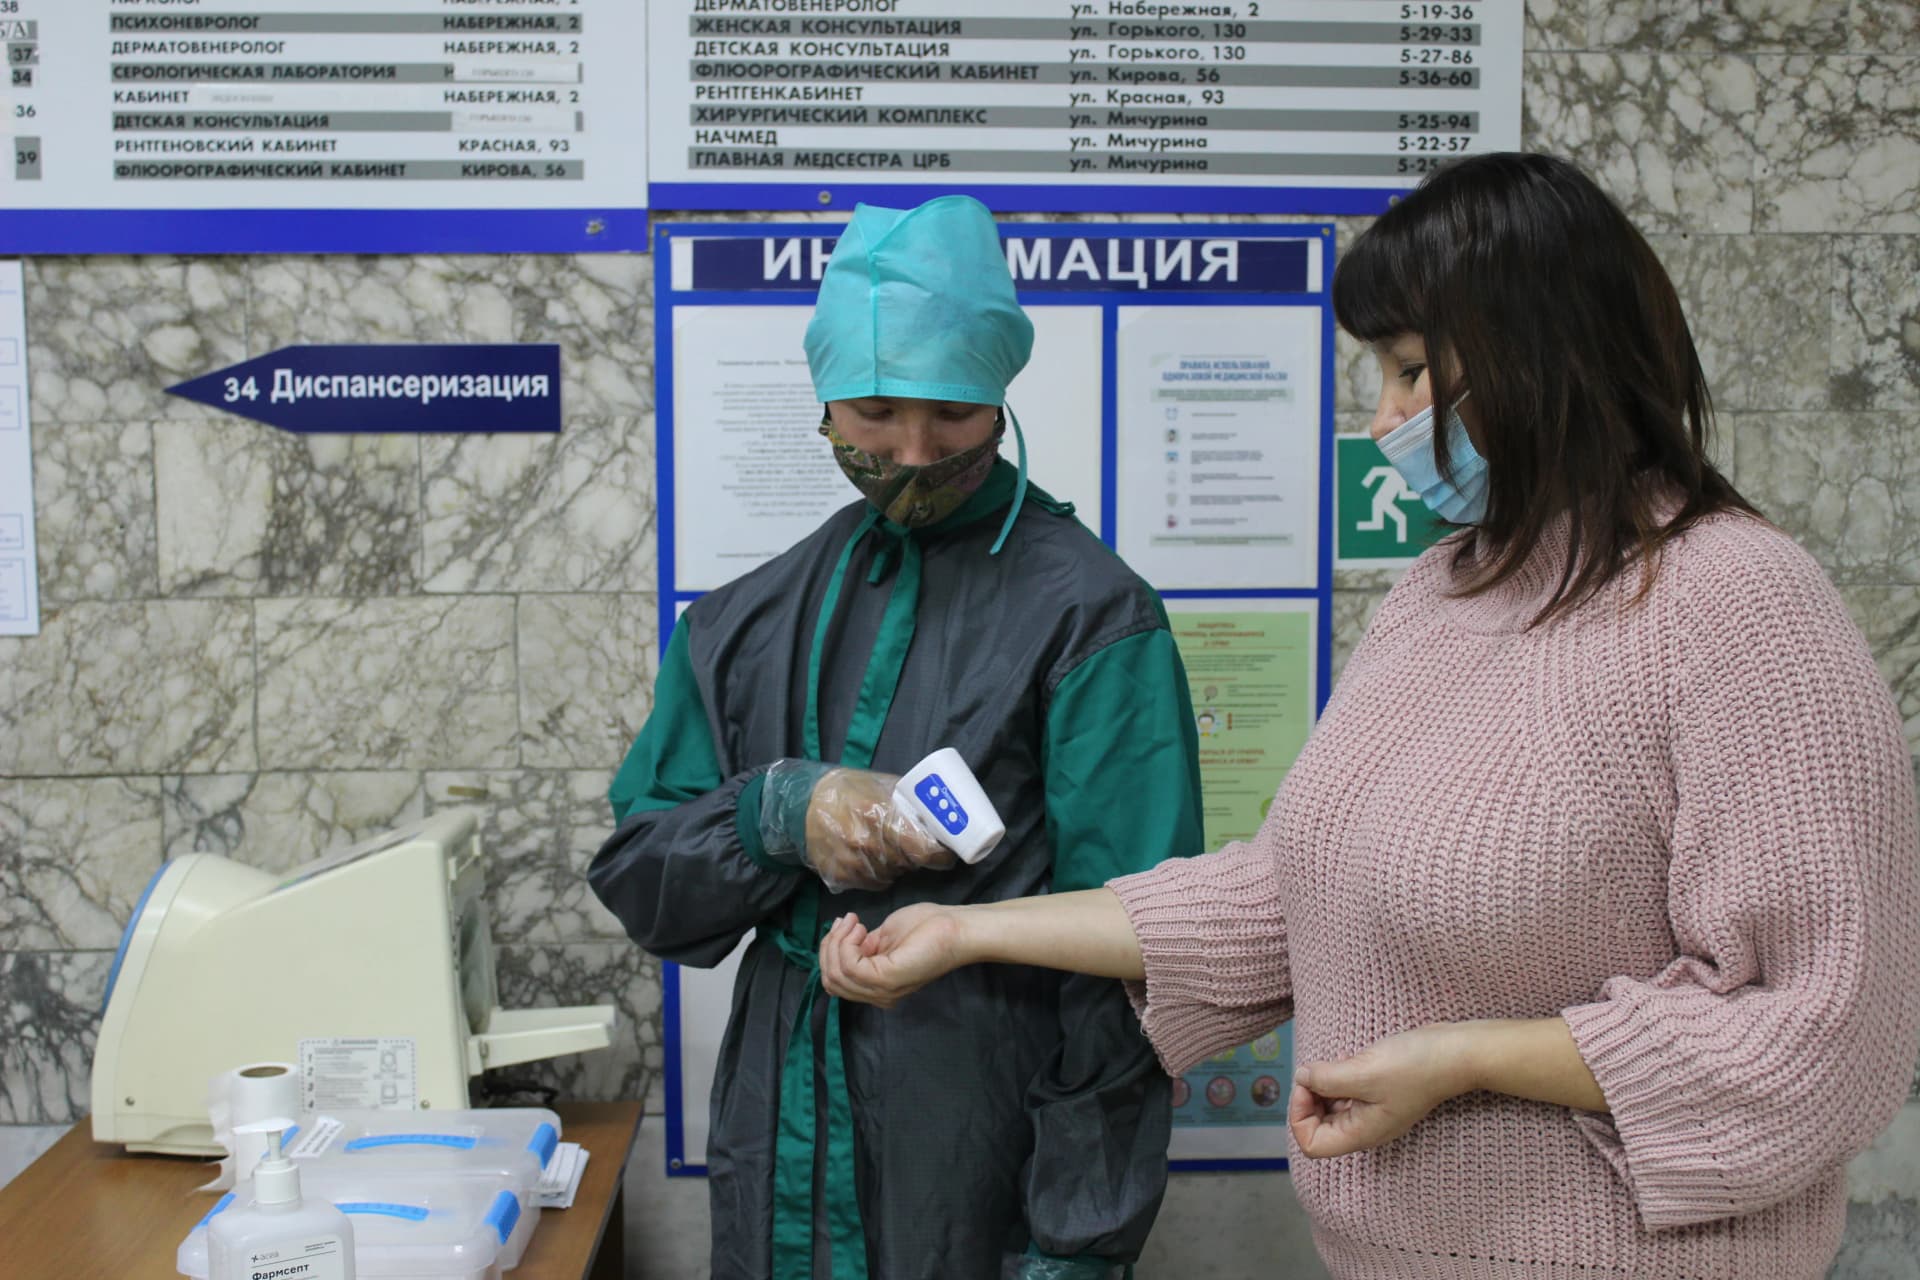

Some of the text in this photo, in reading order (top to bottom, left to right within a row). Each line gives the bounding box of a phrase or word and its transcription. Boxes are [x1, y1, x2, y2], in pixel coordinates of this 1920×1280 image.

[0, 1, 19, 13] 38
[695, 0, 897, 13] ДЕРМАТОВЕНЕРОЛОГ
[1071, 1, 1259, 21] ул. Набережная, 2
[1400, 5, 1473, 20] 5-19-36
[112, 16, 260, 30] ПСИХОНЕВРОЛОГ
[443, 16, 579, 31] НАБЕРЕЖНАЯ, 2
[695, 19, 961, 36] ЖЕНСКАЯ КОНСУЛЬТАЦИЯ
[1070, 25, 1098, 41] ул.
[1213, 23, 1246, 38] 130
[1399, 27, 1473, 42] 5-29-33
[13, 48, 31, 61] 37
[111, 41, 286, 55] ДЕРМАТОВЕНЕРОЛОГ
[444, 41, 579, 55] НАБЕРЕЖНАЯ, 2
[695, 42, 950, 59] ДЕТСКАЯ КОНСУЛЬТАЦИЯ
[1069, 47, 1096, 61] ул.
[1213, 46, 1246, 60] 130
[1400, 49, 1473, 64] 5-27-86
[13, 69, 31, 83] 34
[112, 65, 396, 80] СЕРОЛОГИЧЕСКАЯ ЛАБОРАТОРИЯ
[695, 61, 1039, 80] ФЛЮОРОГРАФИЧЕСКИЙ КАБИНЕТ
[1069, 68, 1220, 85] ул. Кирова, 56
[1399, 70, 1473, 86] 5-36-60
[113, 90, 189, 104] КАБИНЕТ
[444, 90, 579, 105] НАБЕРЕЖНАЯ, 2
[695, 85, 863, 101] РЕНТГЕНКАБИНЕТ
[1069, 89, 1225, 107] ул. Красная, 93
[16, 105, 36, 118] 36
[695, 105, 987, 125] ХИРУРГИЧЕСКИЙ КОМПЛЕКС
[113, 115, 329, 131] ДЕТСКАЯ КОНСУЛЬТАЦИЯ
[1069, 111, 1208, 129] ул. Мичурина
[1398, 114, 1471, 129] 5-25-94
[114, 137, 337, 153] РЕНТГЕНОВСКИЙ КАБИНЕТ
[695, 130, 778, 146] НАЧМЕД
[1069, 133, 1208, 151] ул. Мичурина
[1398, 136, 1471, 151] 5-22-57
[459, 139, 570, 154] КРАСНАЯ, 93
[16, 150, 37, 165] 39
[695, 152, 951, 169] ГЛАВНАЯ МЕДСЕСТРА ЦРБ
[1069, 155, 1208, 173] ул. Мичурина
[115, 161, 406, 178] ФЛЮОРОГРАФИЧЕСКИЙ КАБИНЕТ
[462, 164, 565, 179] КИРОВА, 56
[763, 238, 1239, 289] ИНМАЦИЯ
[224, 369, 549, 404] 34 Диспансеризация
[252, 1264, 310, 1280] Фармсепт
